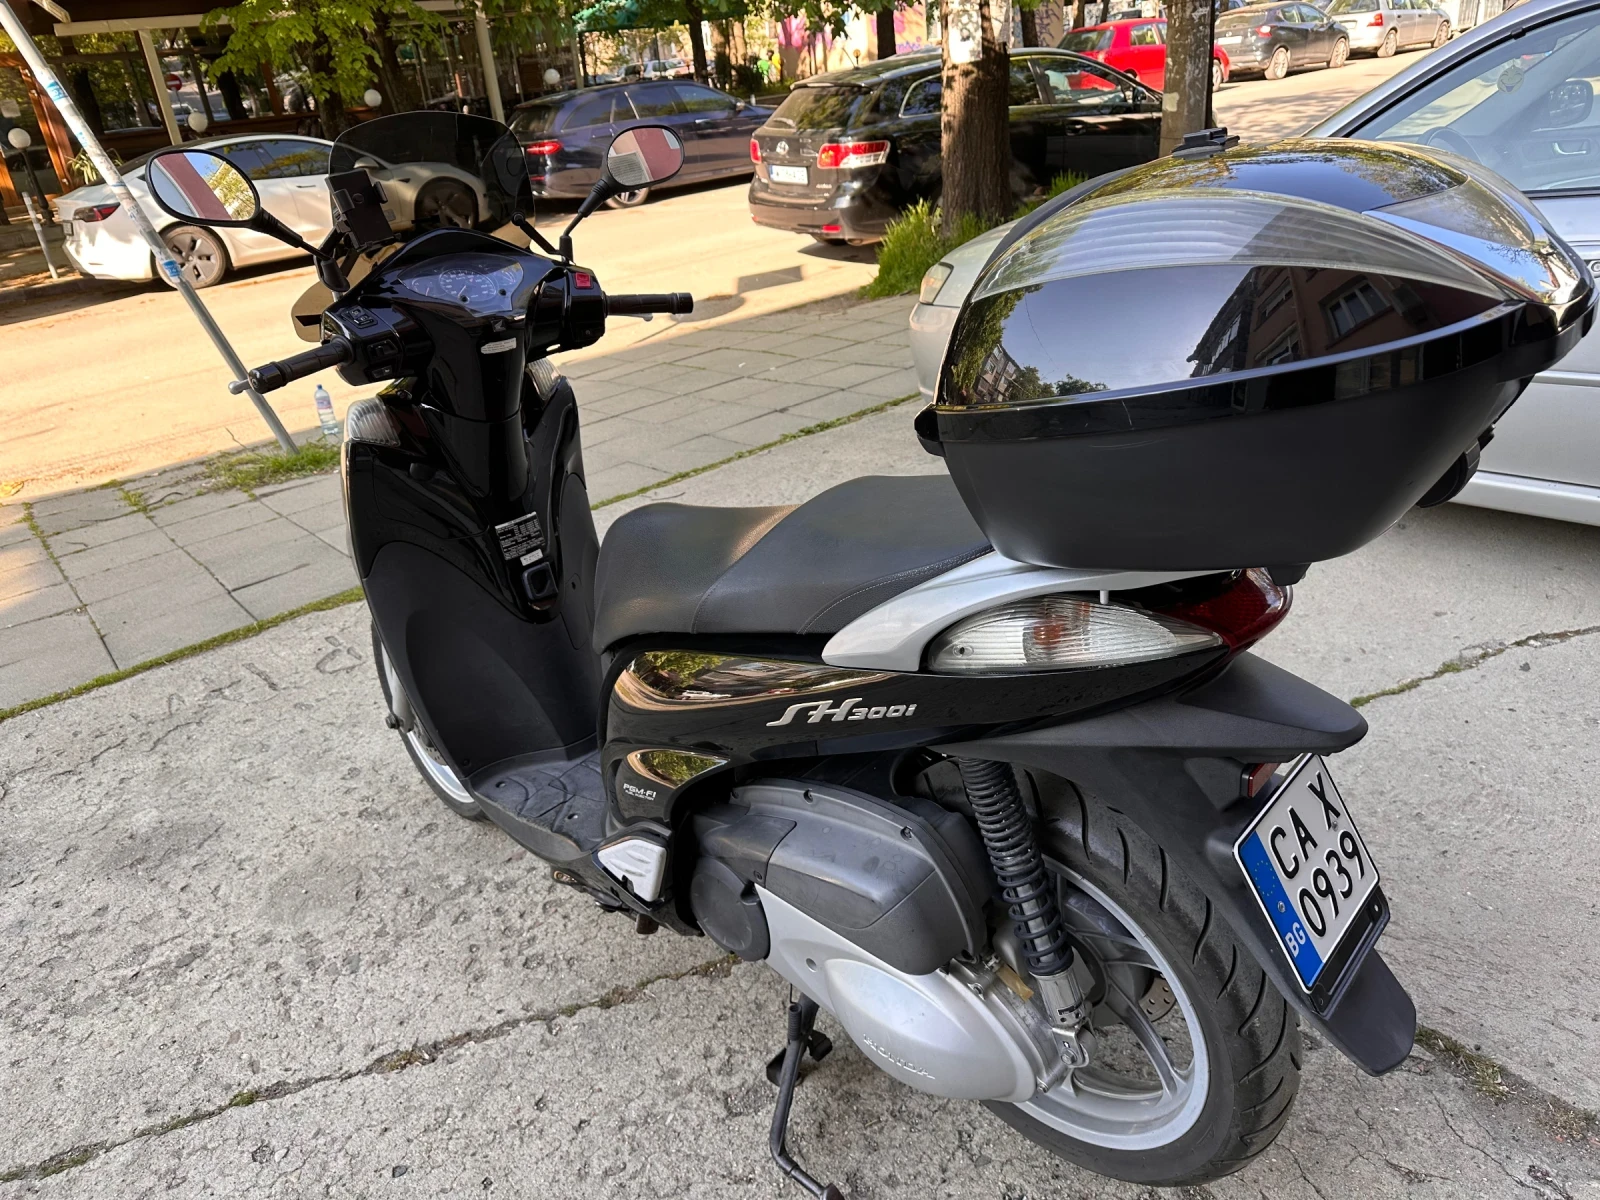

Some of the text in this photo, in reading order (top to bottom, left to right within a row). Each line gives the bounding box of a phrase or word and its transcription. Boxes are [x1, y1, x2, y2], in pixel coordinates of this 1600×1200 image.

[623, 783, 657, 798] PGM-FI
[1268, 771, 1341, 880] CA X
[1297, 830, 1365, 938] 0939
[1285, 922, 1307, 957] BG
